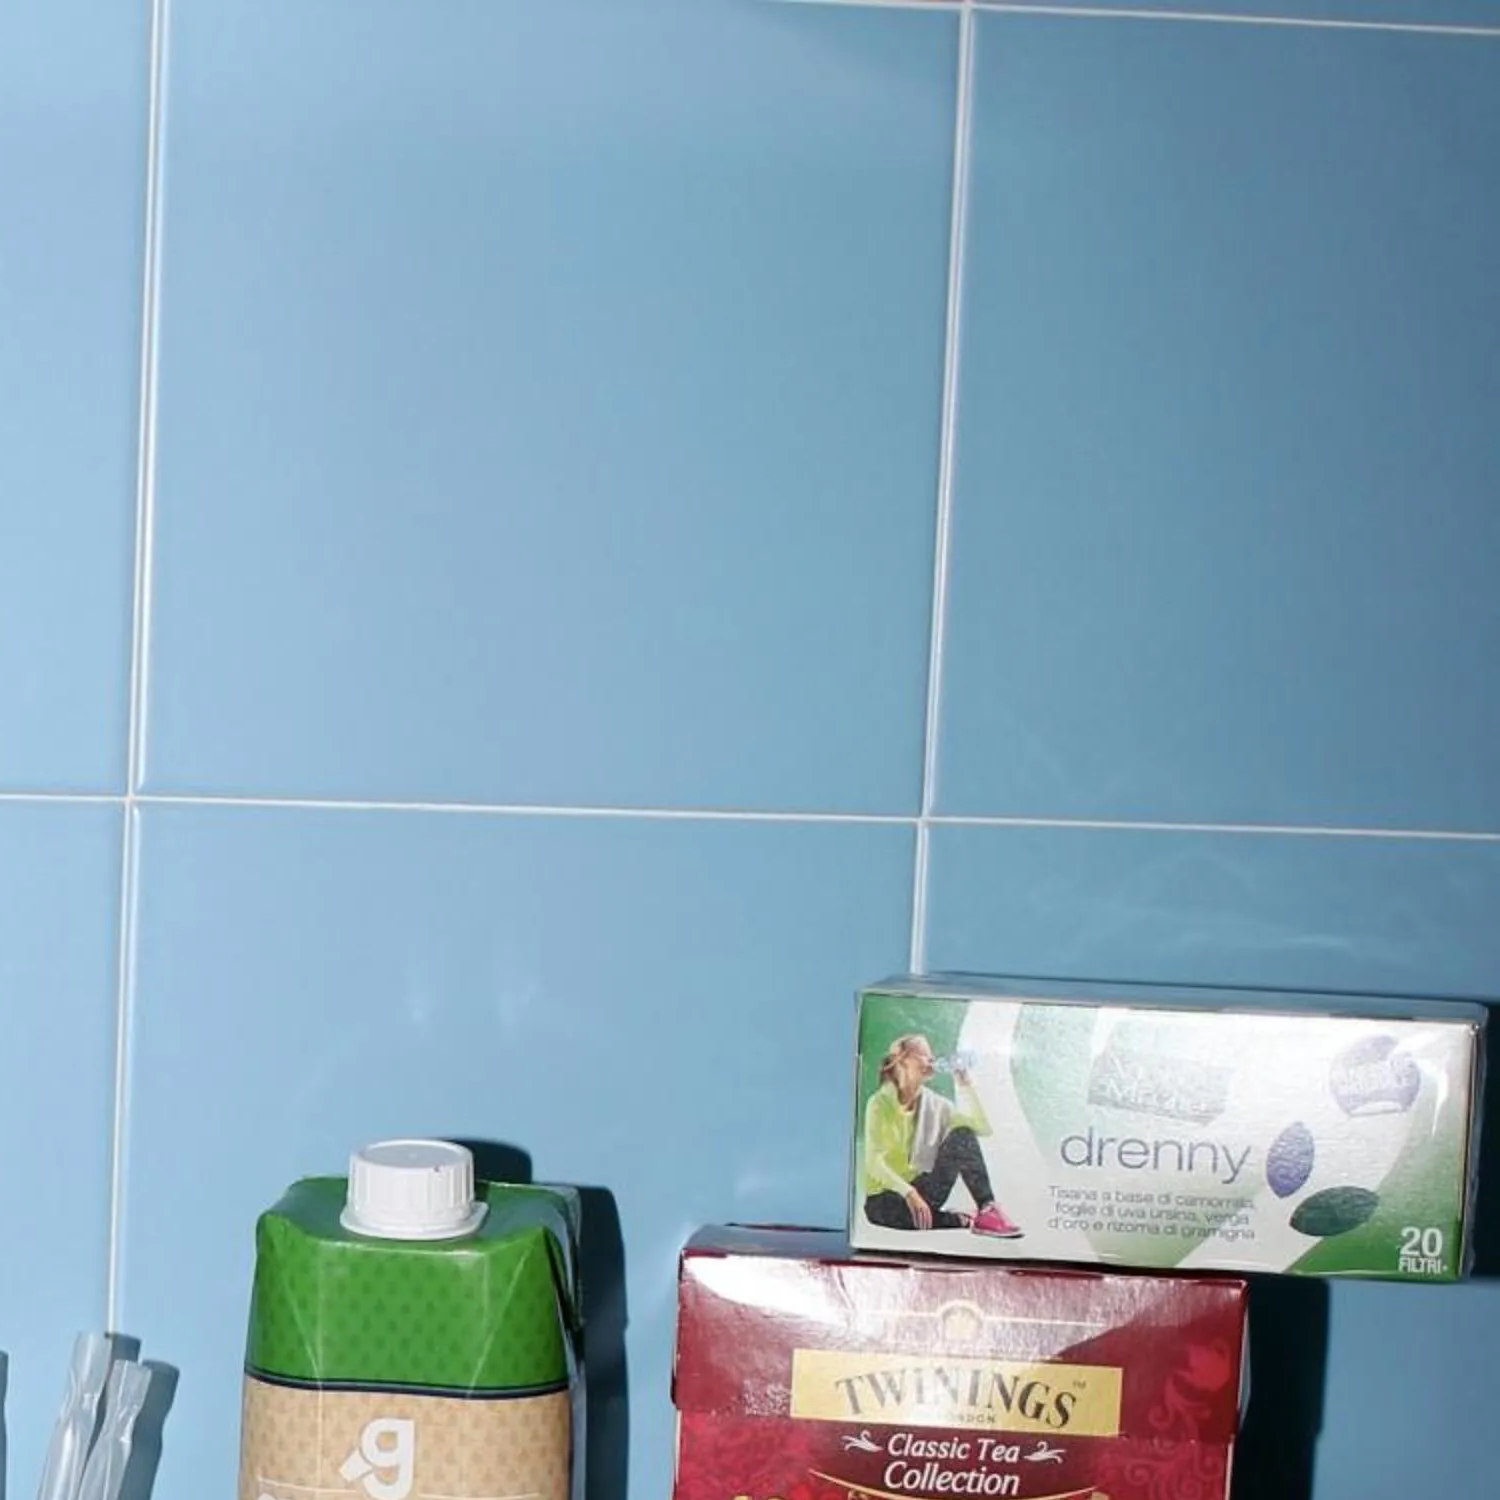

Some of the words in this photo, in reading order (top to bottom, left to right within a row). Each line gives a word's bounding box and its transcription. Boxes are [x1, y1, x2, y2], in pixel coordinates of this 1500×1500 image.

[1060, 1126, 1252, 1185] drenny
[1400, 1226, 1443, 1258] 20
[834, 1365, 1078, 1430] TWININGS
[887, 1432, 972, 1461] Classic
[976, 1437, 1021, 1464] Tea
[883, 1460, 1021, 1496] Collection
